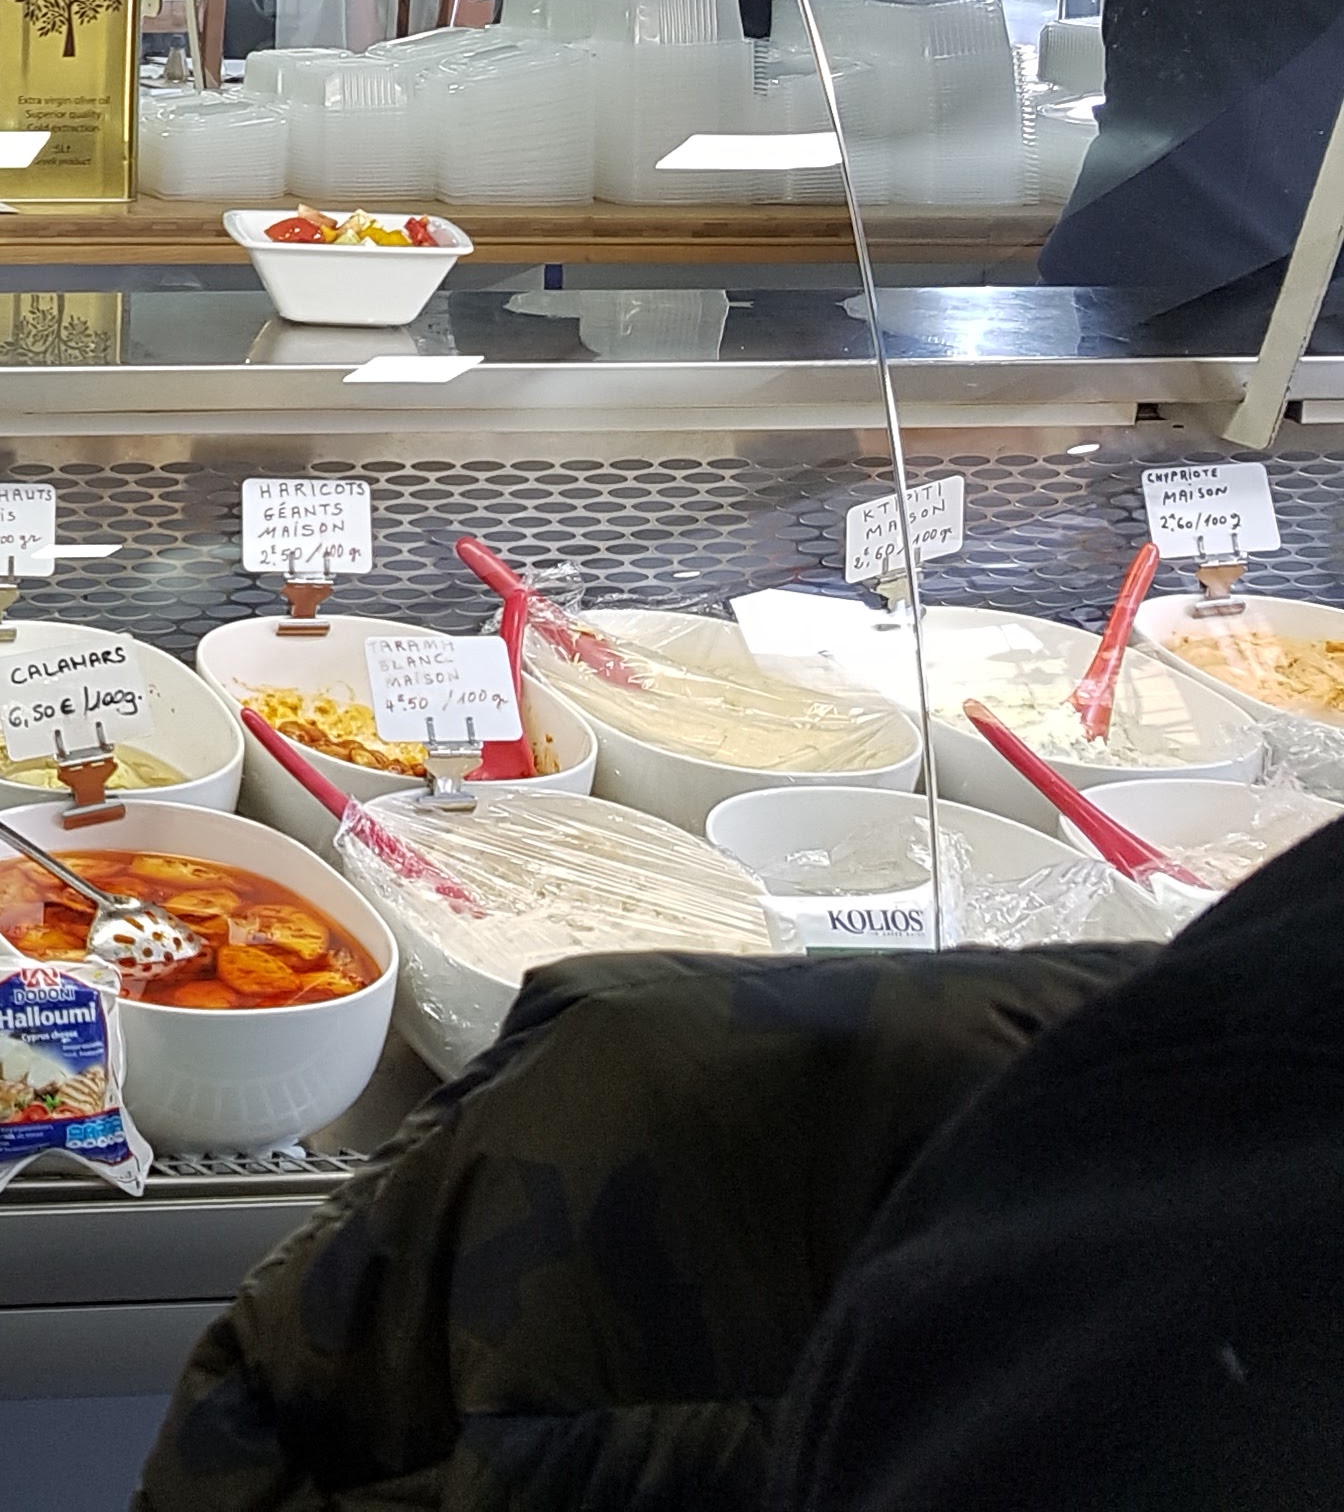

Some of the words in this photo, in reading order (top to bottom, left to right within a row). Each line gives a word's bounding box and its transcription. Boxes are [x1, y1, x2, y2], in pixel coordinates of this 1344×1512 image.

[1147, 468, 1218, 484] CHYPRIOTE
[260, 481, 365, 499] HARICOTS
[1162, 484, 1227, 505] MAISON
[264, 502, 343, 521] GÉANTS
[865, 500, 946, 538] MASON
[258, 521, 345, 538] MAISON
[386, 671, 460, 688] MAISON
[828, 909, 923, 934] KOLIOS
[13, 988, 75, 1005] DODONI
